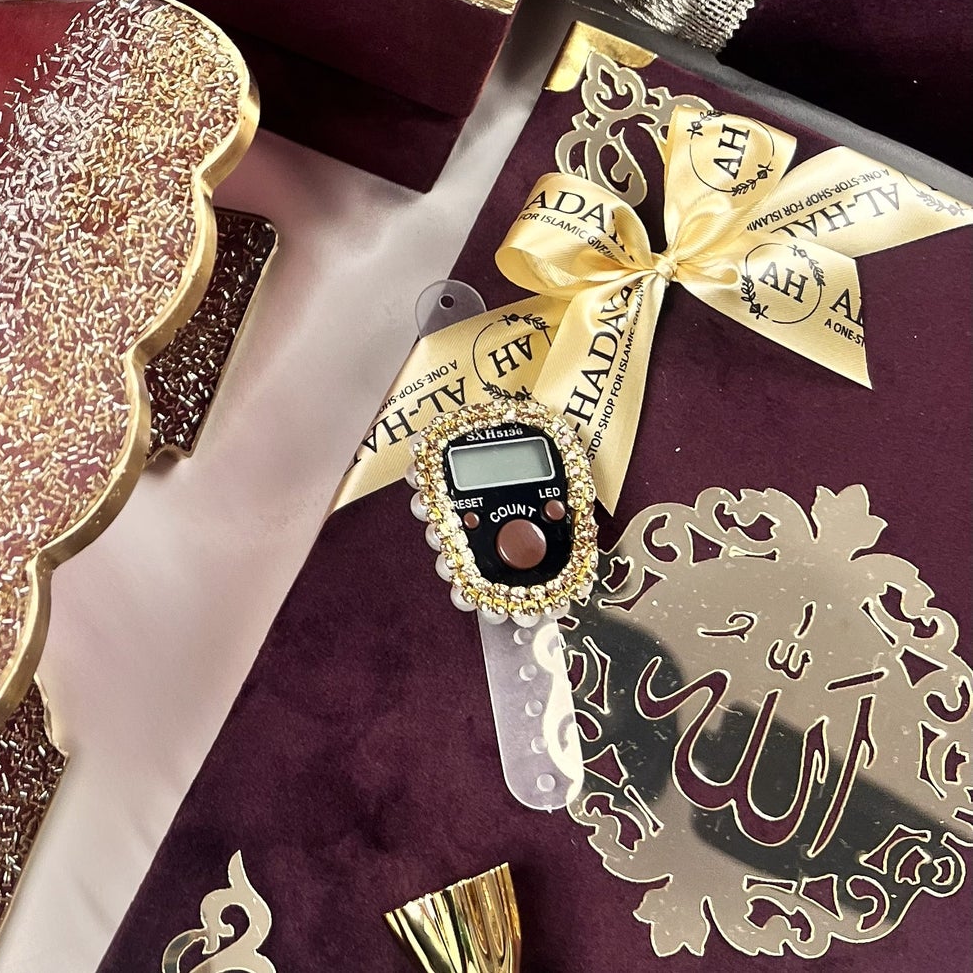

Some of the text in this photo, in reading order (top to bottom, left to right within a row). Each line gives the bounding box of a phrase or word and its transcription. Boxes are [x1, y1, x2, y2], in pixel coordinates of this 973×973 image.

[713, 124, 751, 180] AH
[805, 170, 881, 206] ONE-STOP-SHOP
[783, 199, 804, 218] FOR
[541, 214, 589, 240] ISLAMIC
[758, 261, 808, 303] AH
[824, 318, 832, 329] A
[449, 359, 459, 371] A
[488, 334, 532, 378] AH
[611, 373, 625, 398] FOR
[619, 327, 636, 373] ISLAMIC
[343, 376, 467, 476] AL-HA
[453, 496, 484, 510] RESET
[538, 486, 561, 499] LED
[489, 503, 537, 523] COUNT
